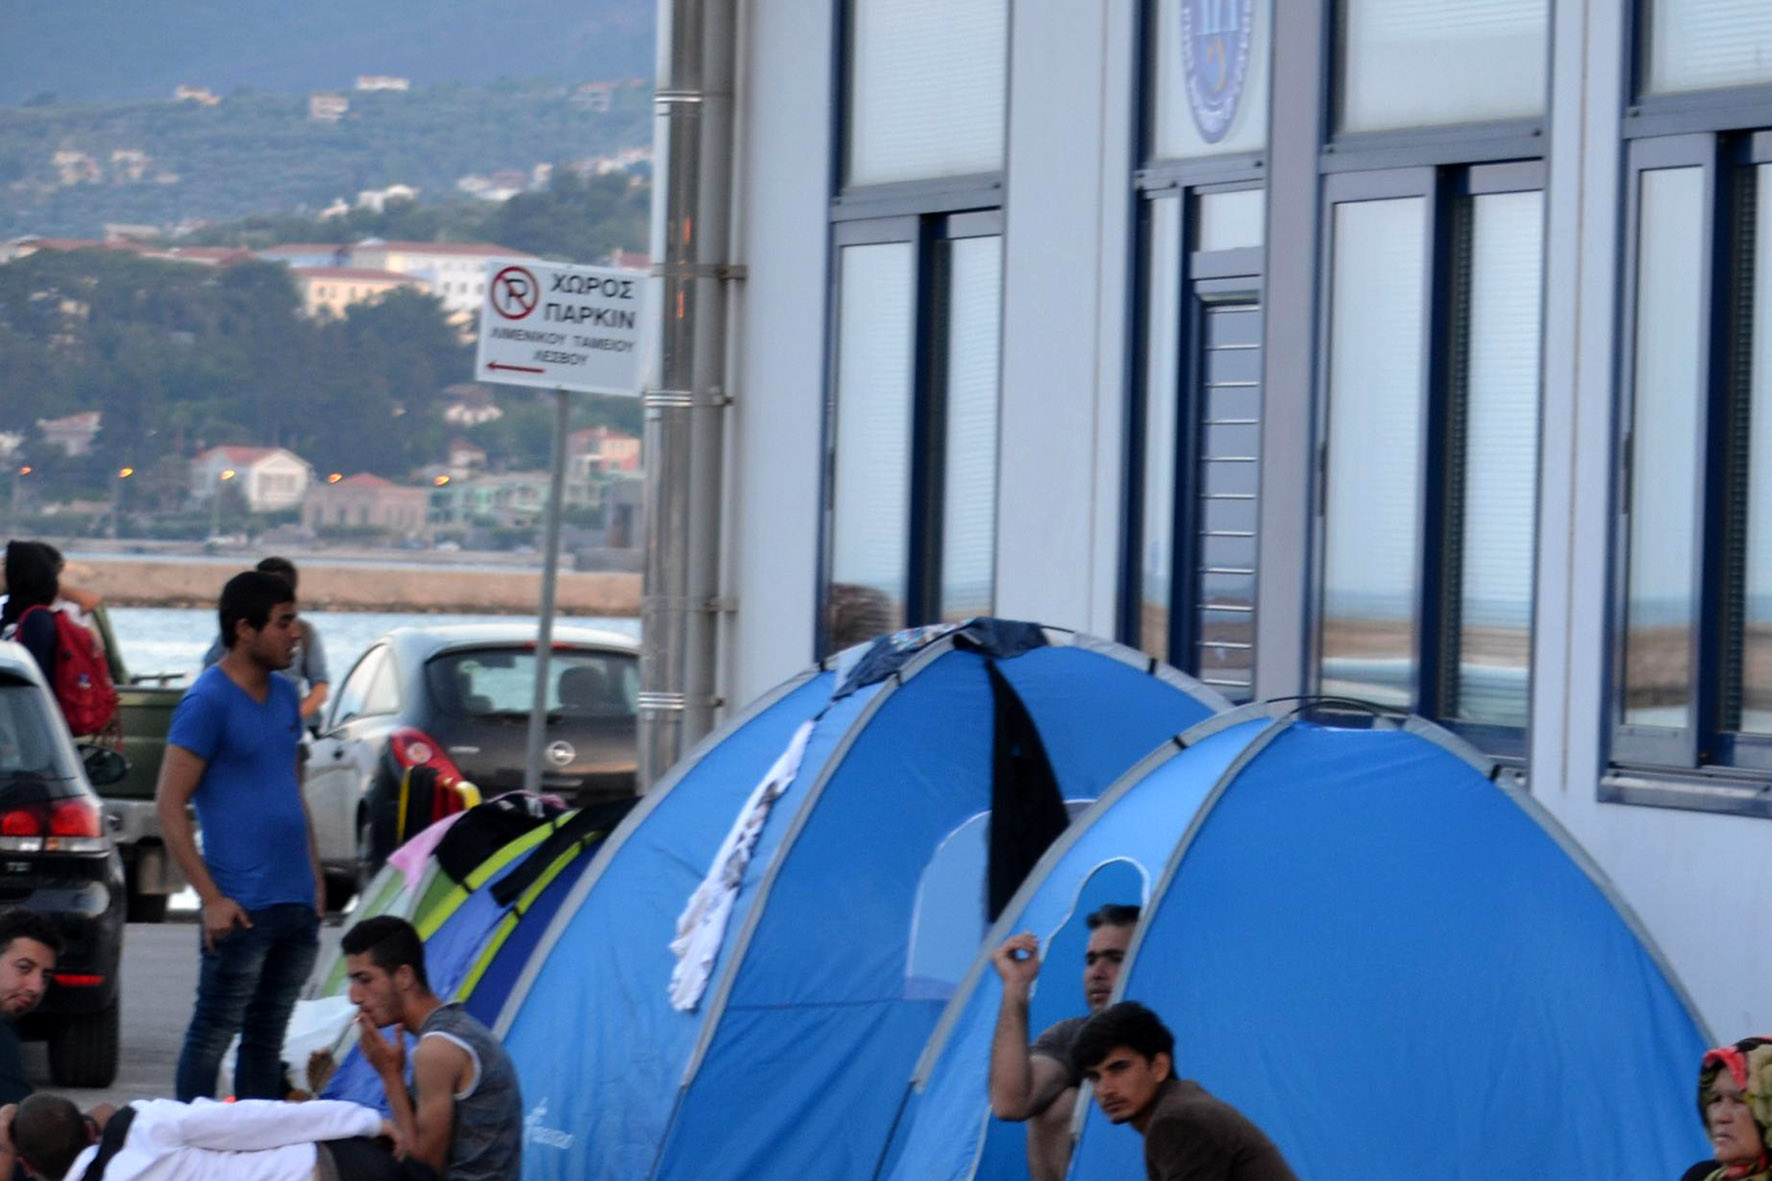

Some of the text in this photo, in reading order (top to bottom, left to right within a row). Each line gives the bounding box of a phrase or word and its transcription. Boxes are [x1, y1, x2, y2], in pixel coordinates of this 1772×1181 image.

[549, 273, 633, 299] ΧΩΡΟΣ
[543, 303, 636, 329] ΠΑΡΚΙΝ
[532, 349, 589, 365] ΛΕΣΒΟΥ
